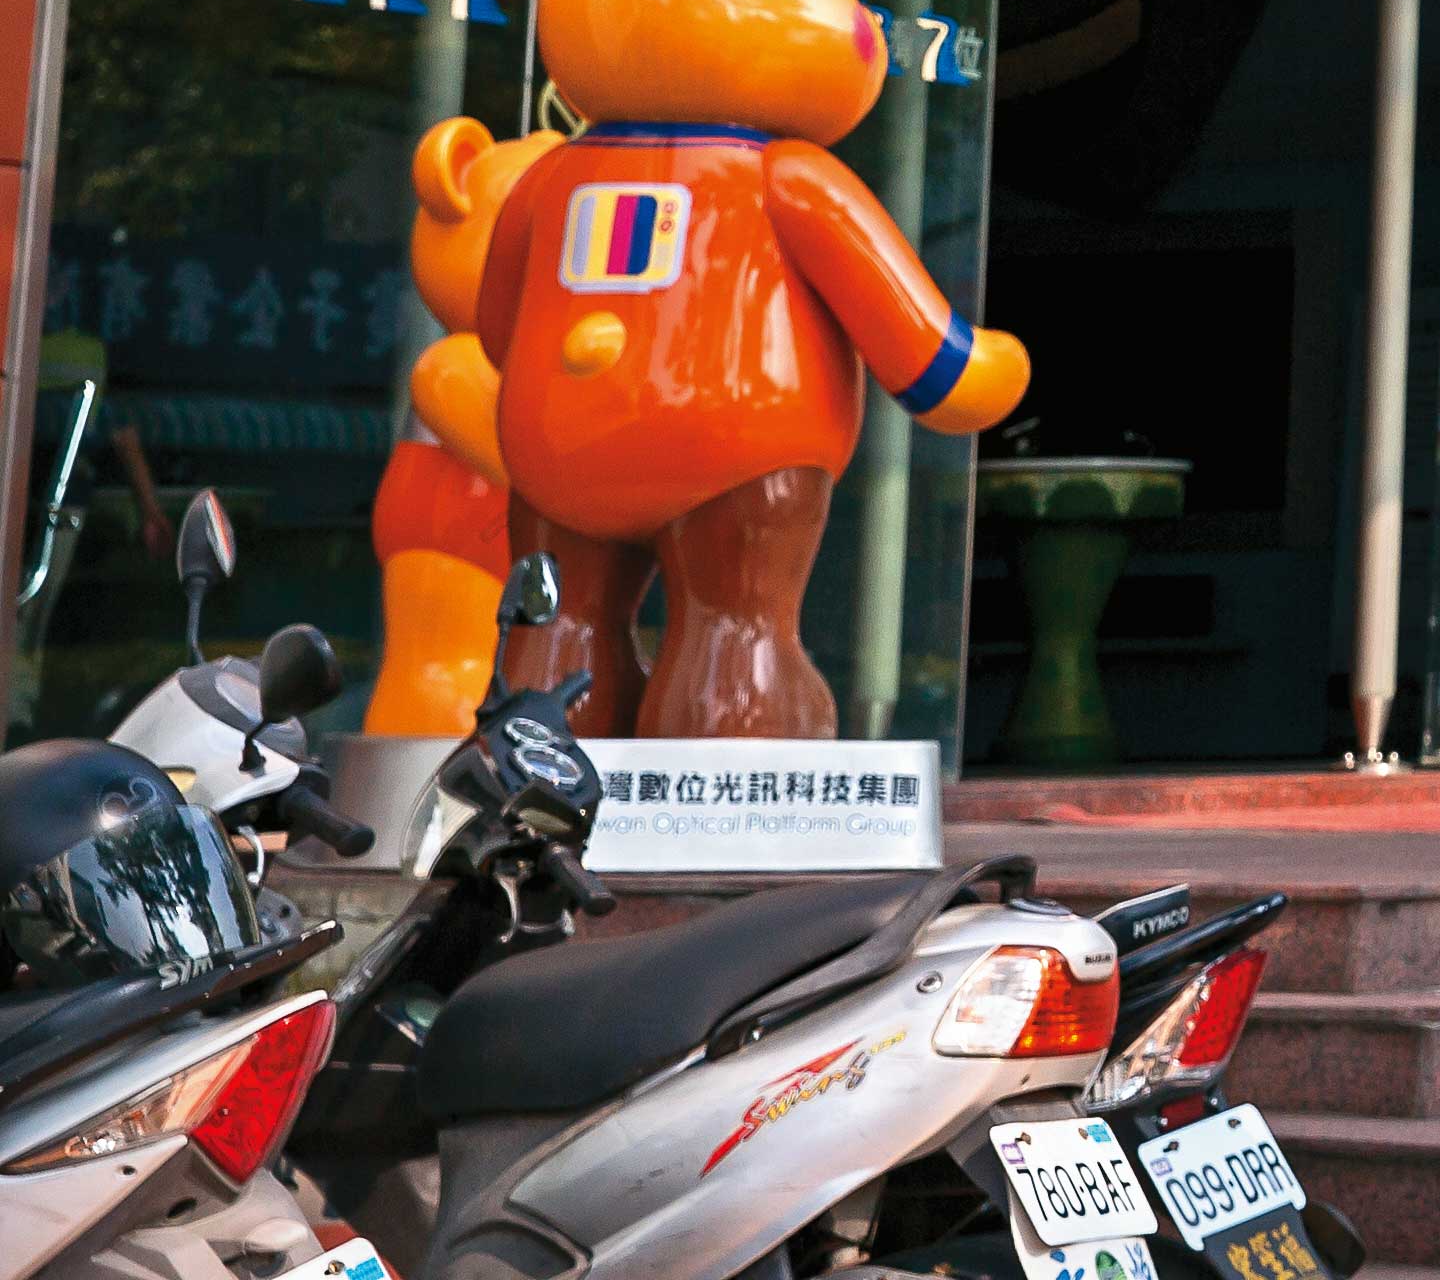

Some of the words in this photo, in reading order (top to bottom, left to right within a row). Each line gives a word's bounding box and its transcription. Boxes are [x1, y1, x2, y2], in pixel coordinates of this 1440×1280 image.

[603, 771, 919, 805] 灣數位光訊科技集團
[652, 812, 742, 837] Optical
[746, 812, 841, 835] Platform
[846, 812, 917, 837] Group
[1132, 906, 1190, 939] KYMCO
